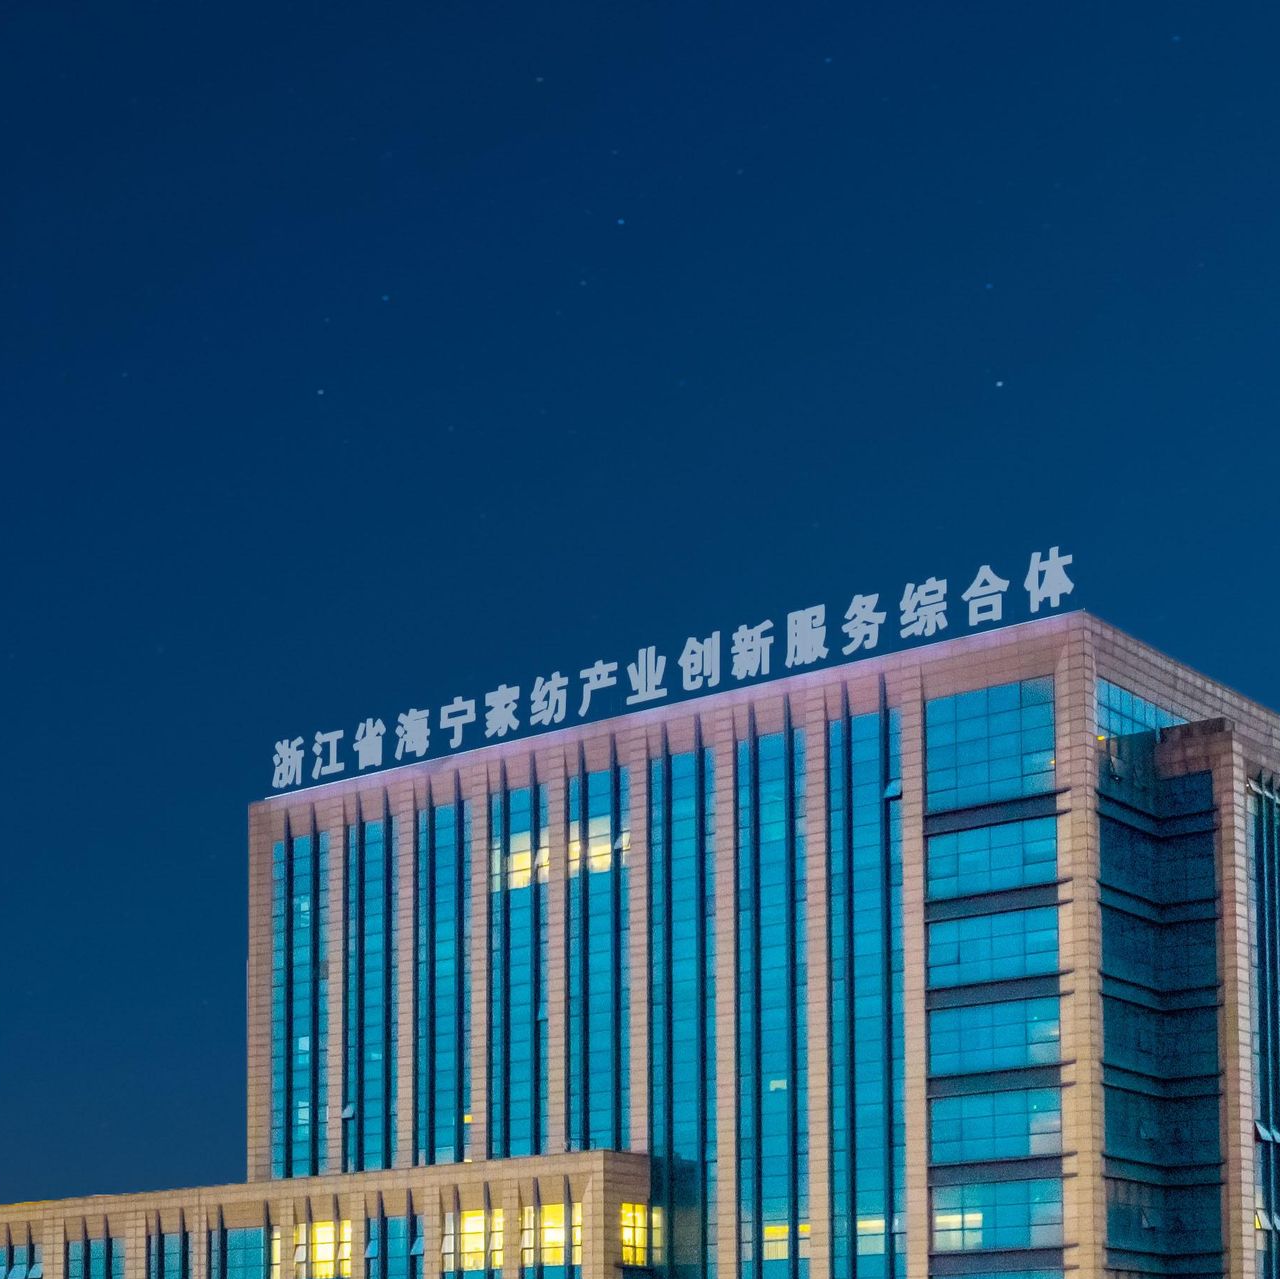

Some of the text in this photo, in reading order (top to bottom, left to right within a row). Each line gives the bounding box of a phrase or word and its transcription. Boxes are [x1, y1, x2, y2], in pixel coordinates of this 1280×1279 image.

[272, 546, 1074, 789] 浙江省海宁家纺产业创新服务综合体
